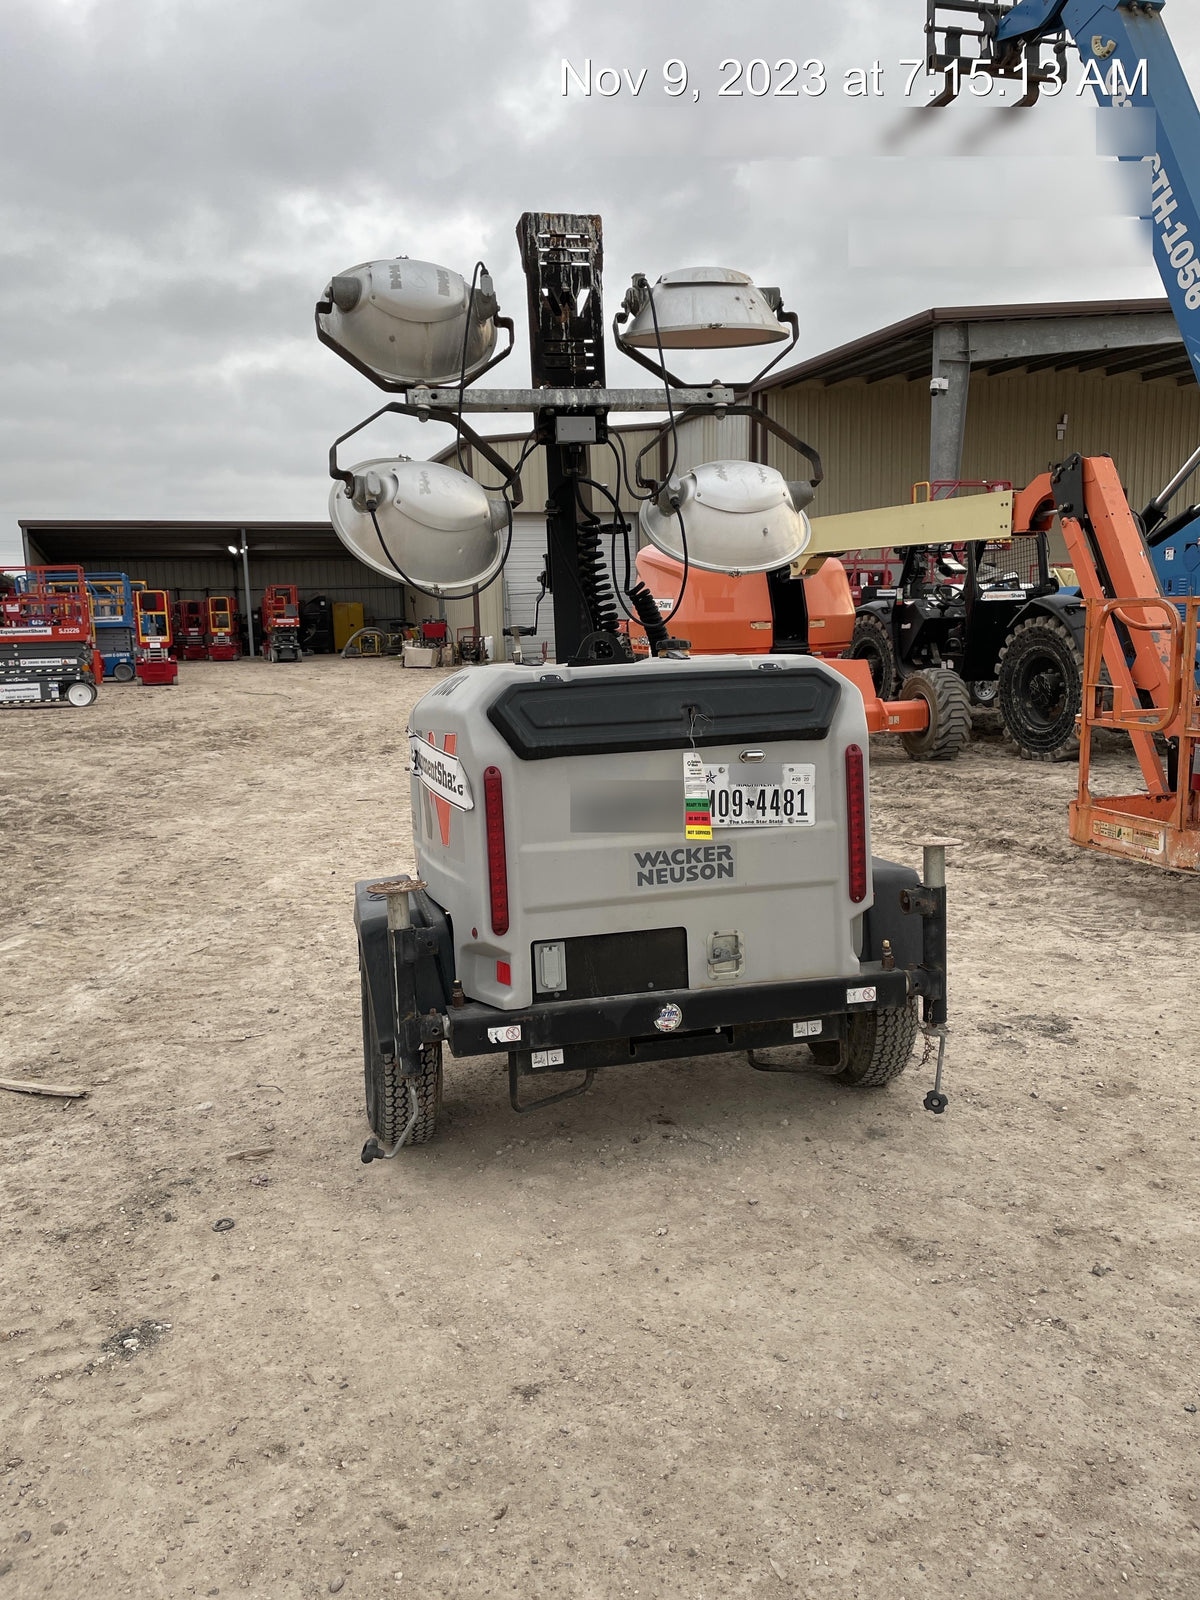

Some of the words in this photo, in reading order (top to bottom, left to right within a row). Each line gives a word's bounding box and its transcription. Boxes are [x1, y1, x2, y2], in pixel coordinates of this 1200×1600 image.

[756, 789, 808, 817] 4481
[634, 845, 733, 868] WACKER
[637, 862, 734, 886] NEUSON
